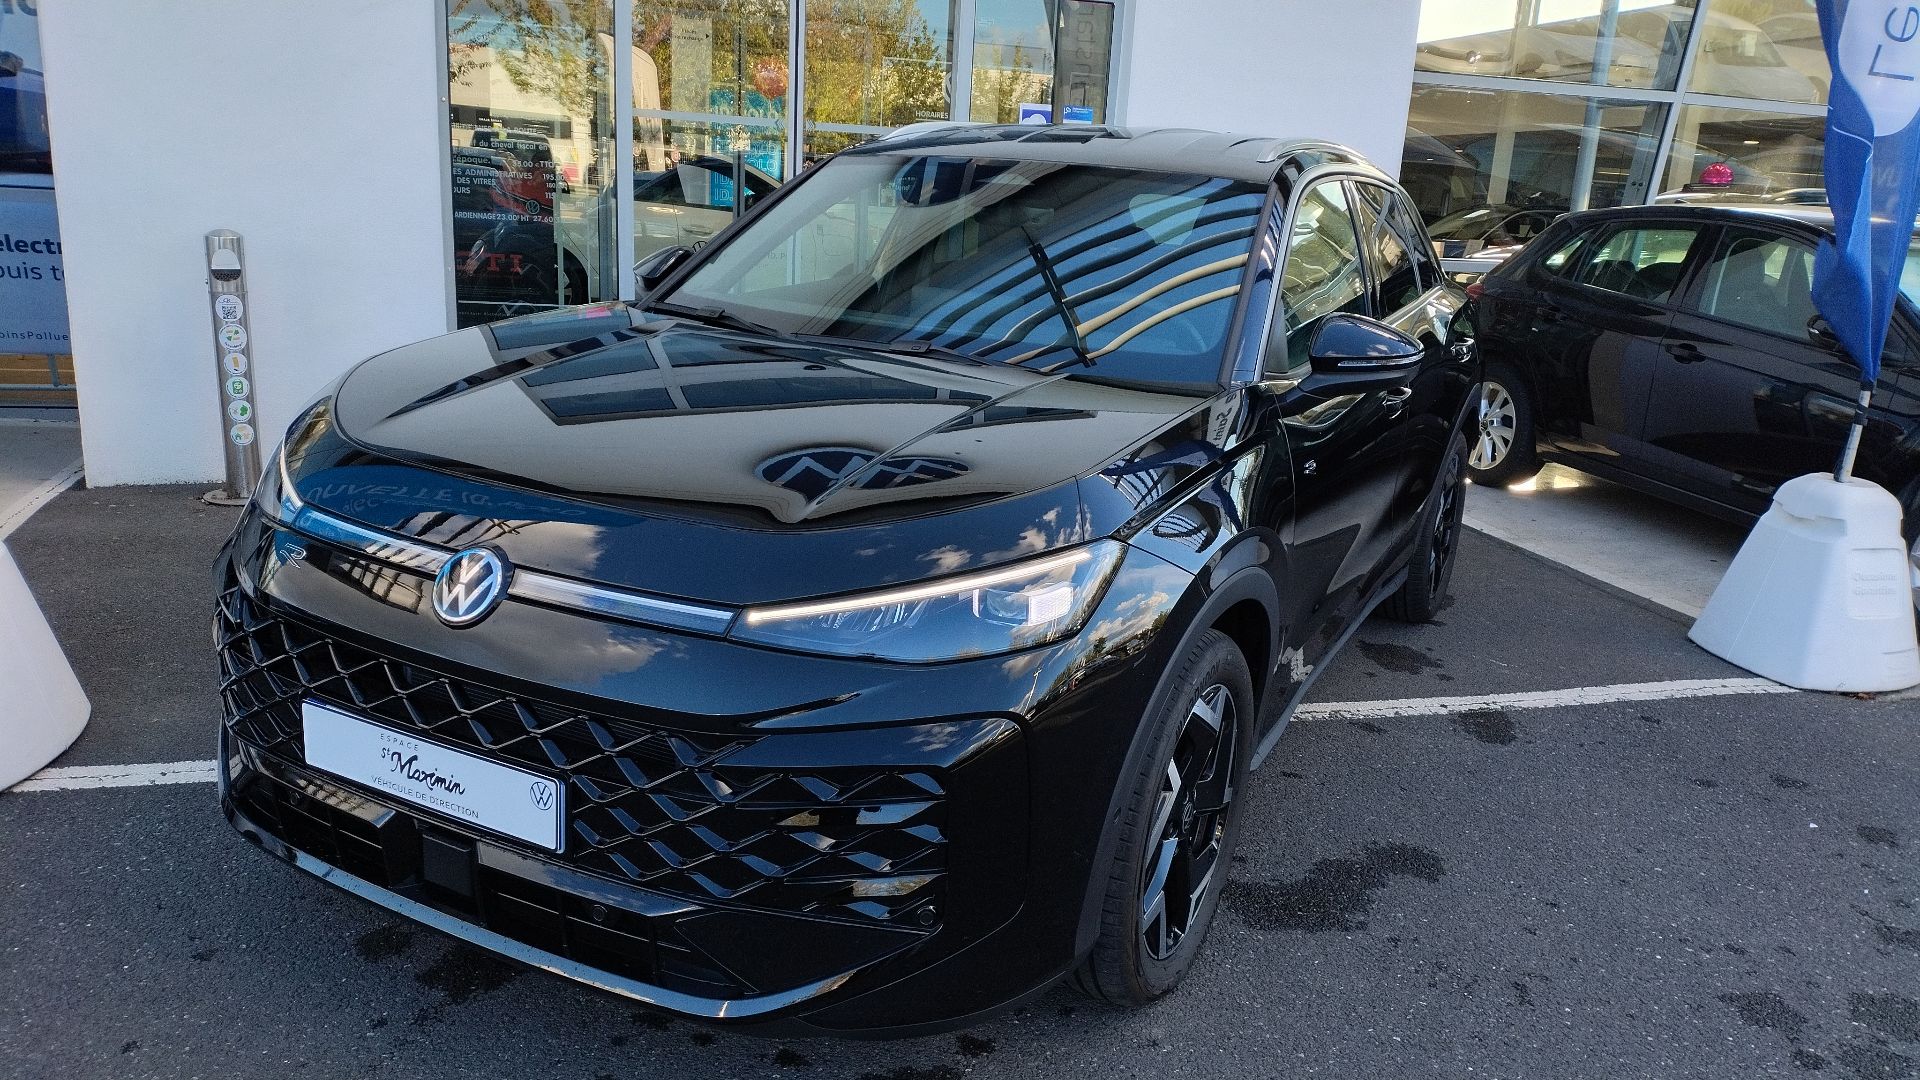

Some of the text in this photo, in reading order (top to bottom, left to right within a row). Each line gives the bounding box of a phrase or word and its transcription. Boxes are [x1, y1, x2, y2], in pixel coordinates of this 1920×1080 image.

[915, 110, 949, 119] HORAIRES
[491, 140, 514, 149] cheval
[516, 142, 536, 150] fiscal
[456, 176, 471, 184] DES
[472, 178, 496, 186] VITRES
[465, 169, 533, 179] ADMINISTRATIVES
[0, 234, 63, 255] lect
[379, 733, 420, 752] ESPACE
[390, 751, 466, 796] Maximin
[371, 775, 480, 820] VÉHICULE DE DIRECTION
